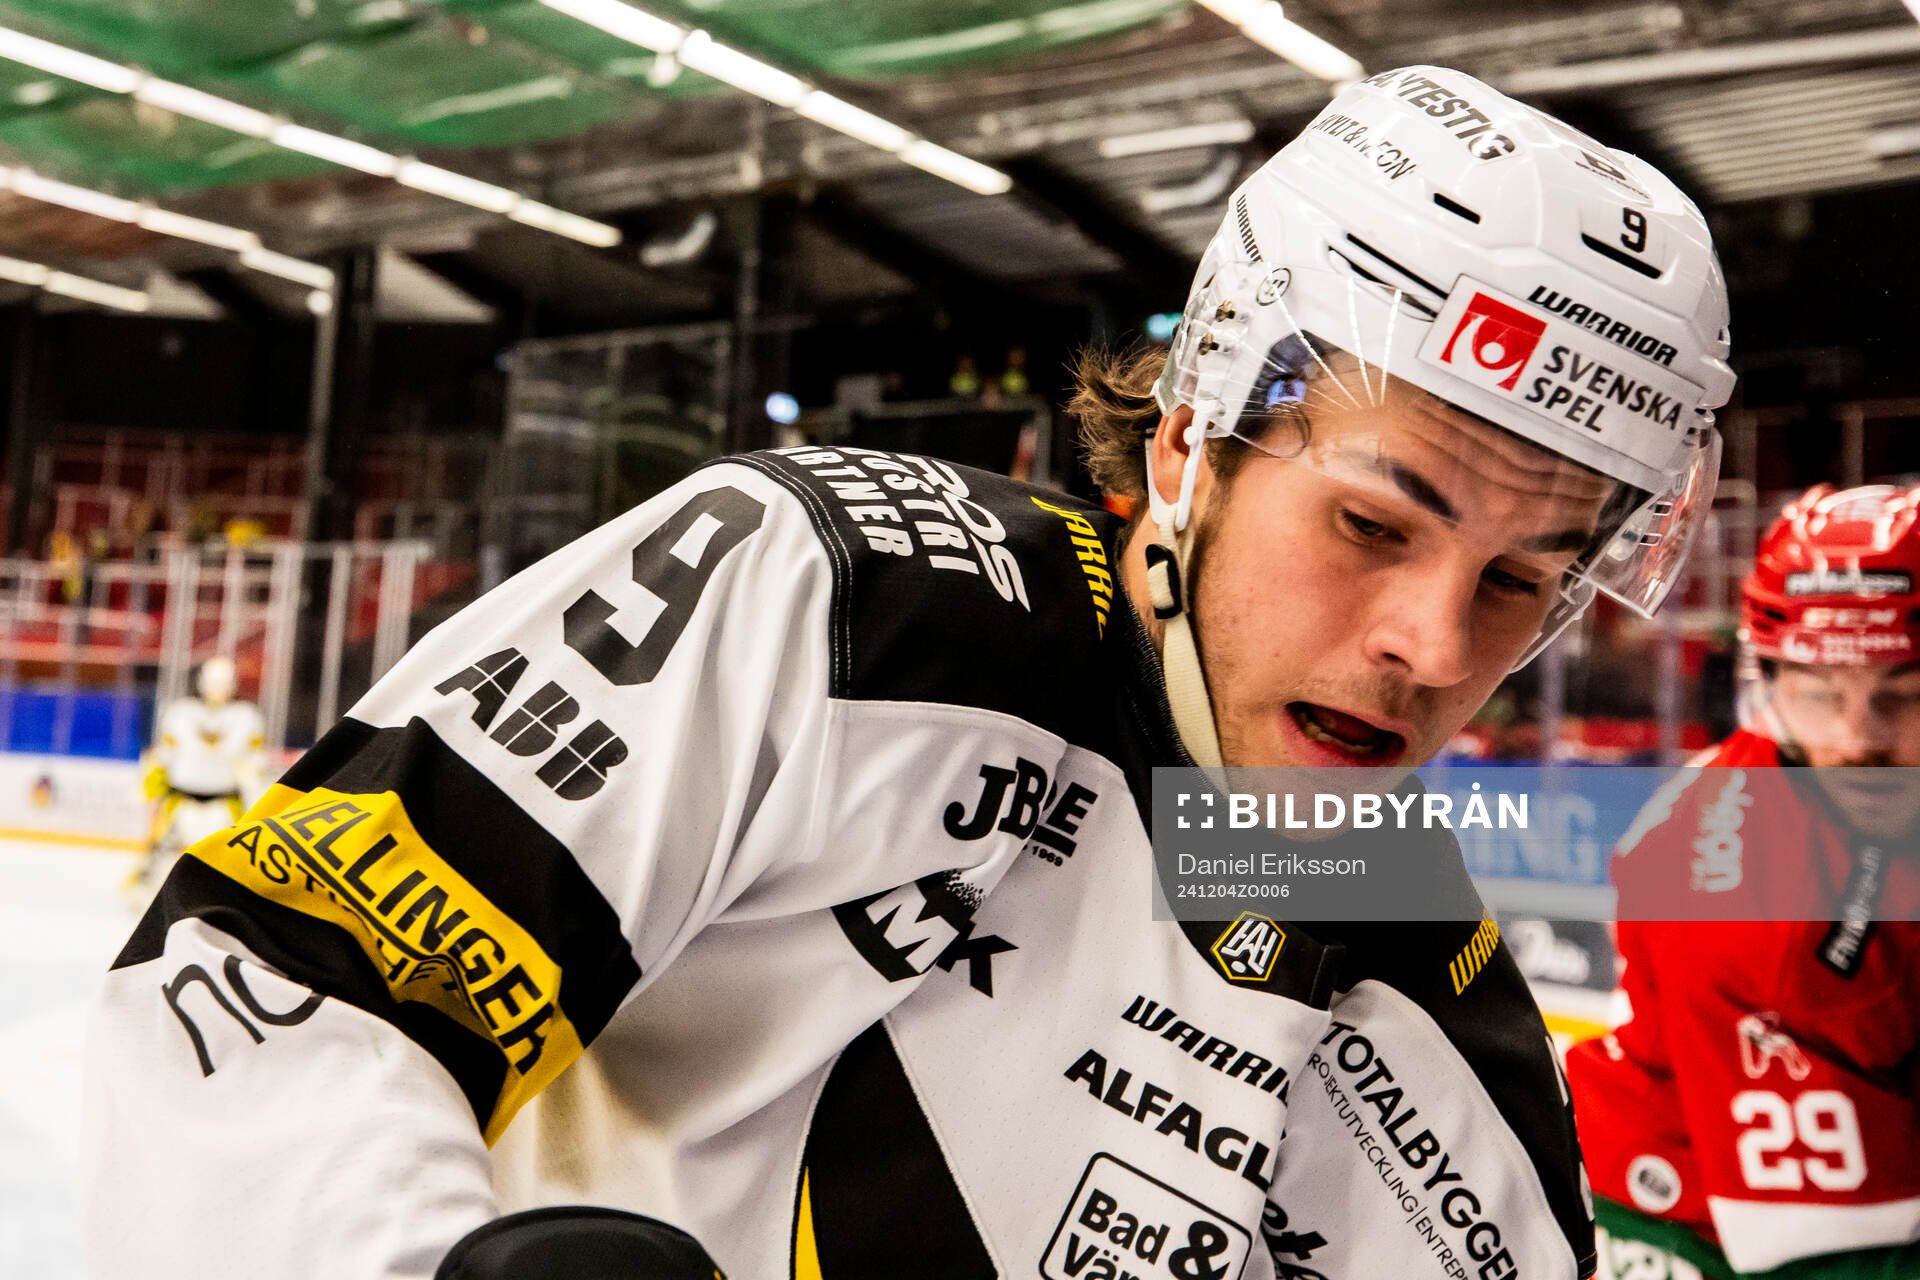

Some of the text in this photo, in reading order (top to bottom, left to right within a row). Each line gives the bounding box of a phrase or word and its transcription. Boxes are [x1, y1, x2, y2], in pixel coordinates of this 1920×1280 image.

[1361, 70, 1516, 160] ANTESTIG
[1620, 206, 1648, 254] 9
[1527, 285, 1679, 367] WARRIOR
[1525, 376, 1605, 433] SPEL
[1543, 345, 1684, 431] SVENSKA
[562, 485, 768, 687] 9
[433, 646, 630, 802] ABB
[1032, 845, 1064, 867] 1969
[280, 799, 554, 1077] ELLINGER
[1730, 1089, 1869, 1192] 29
[1078, 1188, 1171, 1266] Bad
[1168, 1220, 1231, 1280] &
